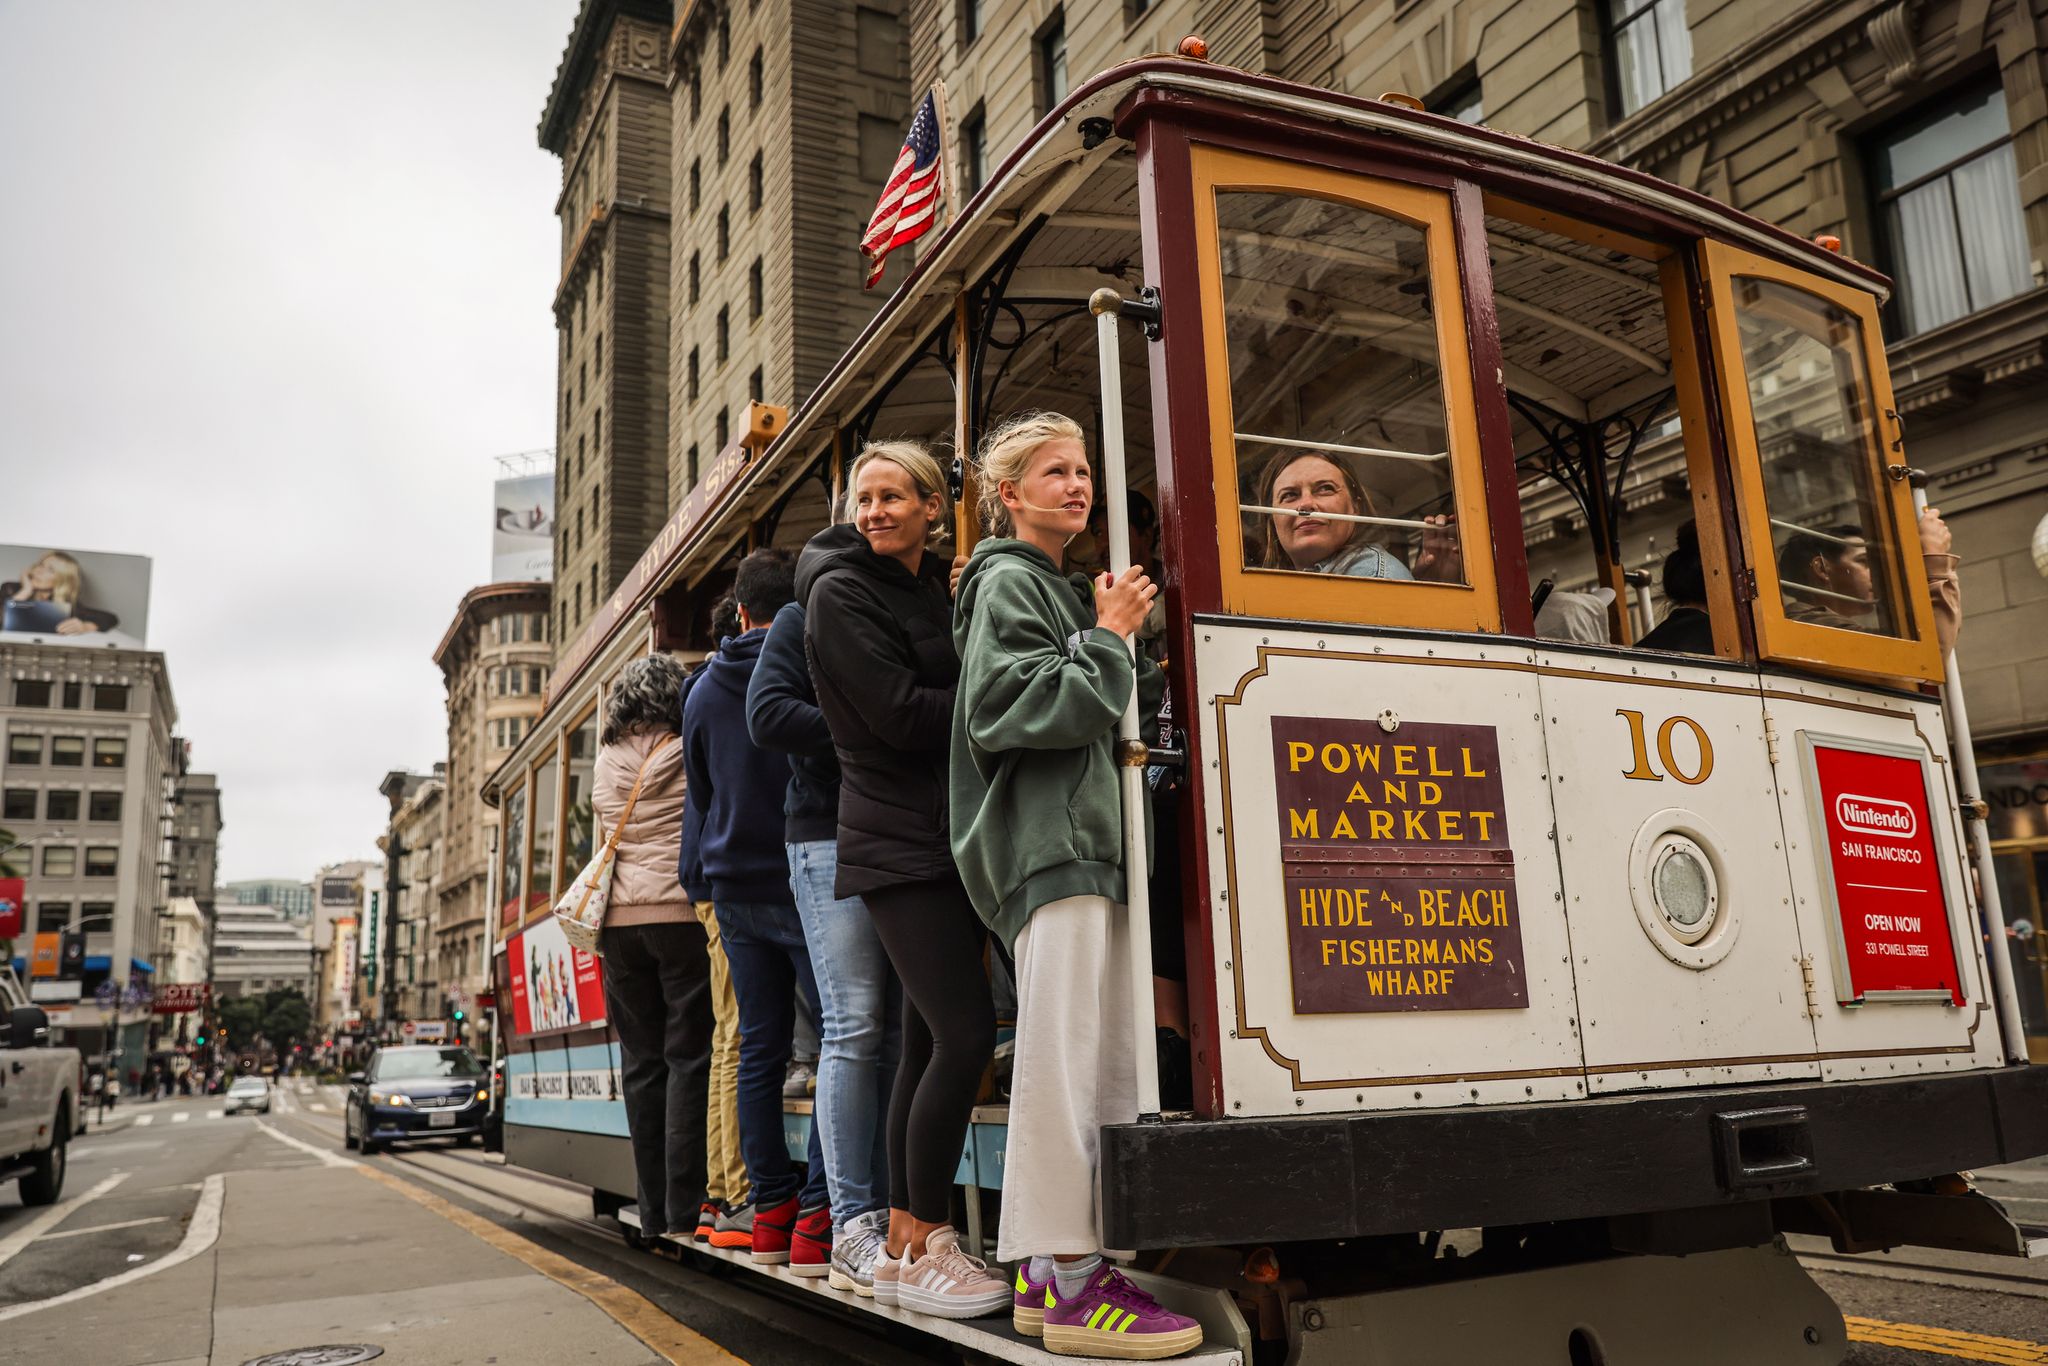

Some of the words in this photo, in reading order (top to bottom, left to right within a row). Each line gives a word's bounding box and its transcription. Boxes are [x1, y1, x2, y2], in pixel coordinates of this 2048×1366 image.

[612, 592, 624, 618] &
[640, 500, 692, 584] HYDE
[1286, 741, 1486, 778] POWELL
[1615, 708, 1714, 785] 10
[1345, 780, 1442, 805] AND
[1288, 808, 1495, 841] MARKET
[1842, 802, 1910, 830] Nintendo
[1841, 841, 1863, 858] SAN
[1864, 844, 1922, 864] FRANCISCO
[1299, 889, 1373, 927] HYDE
[1380, 890, 1415, 926] AND
[1418, 889, 1509, 927] BEACH
[1864, 913, 1894, 931] OPEN
[1894, 915, 1921, 933] NOW
[1321, 938, 1494, 966] FISHERMANS
[1865, 942, 1878, 955] 331
[1878, 943, 1907, 956] POWELL
[1906, 944, 1929, 957] STREET
[1366, 969, 1455, 996] WHARF
